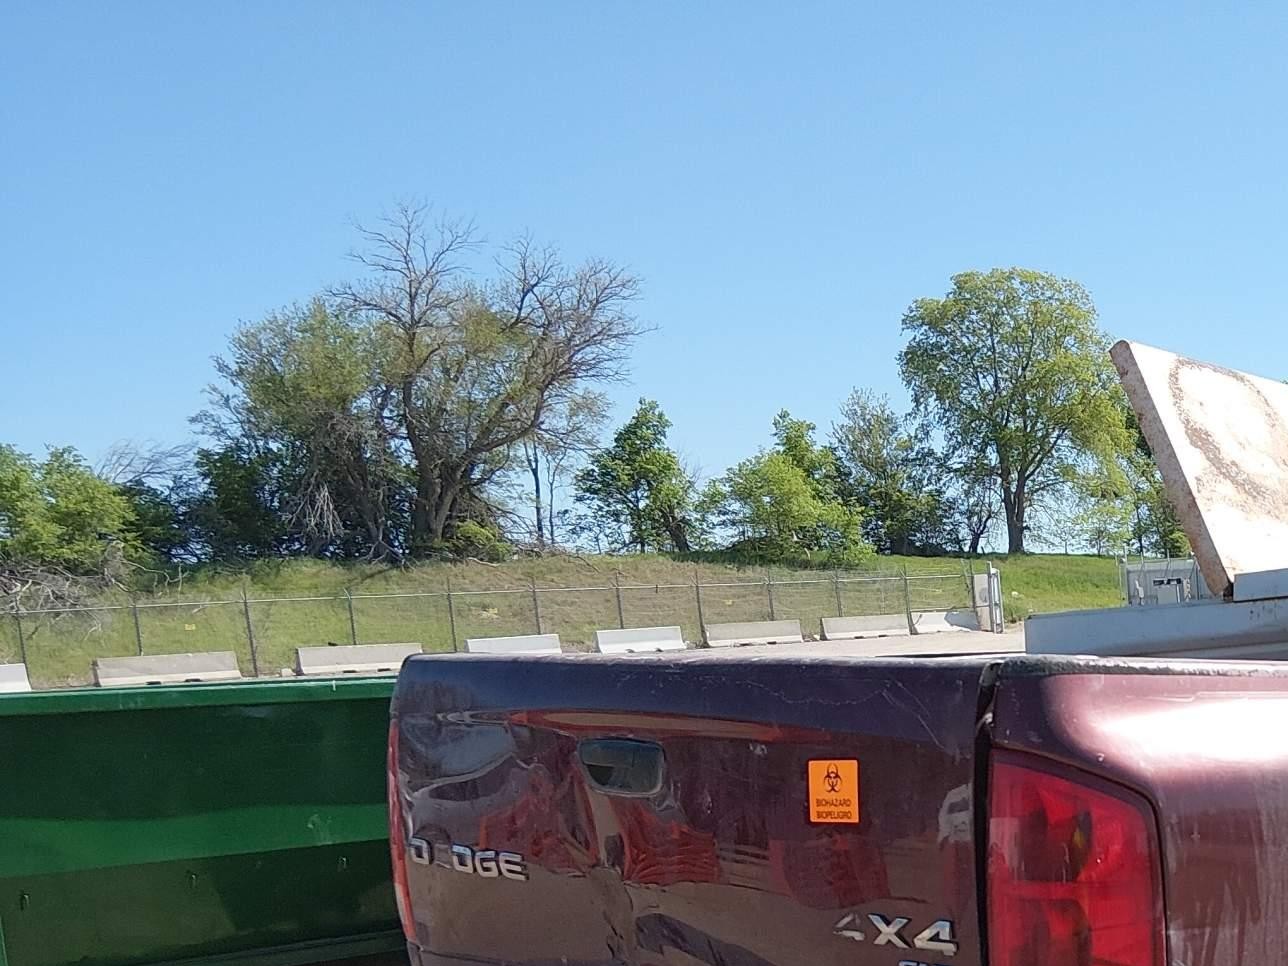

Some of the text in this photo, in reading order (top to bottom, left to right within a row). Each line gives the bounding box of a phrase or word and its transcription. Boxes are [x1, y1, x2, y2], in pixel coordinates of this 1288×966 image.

[816, 798, 852, 807] BIOHAZARD
[816, 810, 852, 819] BIOPELIGRO
[408, 836, 530, 882] DDGE
